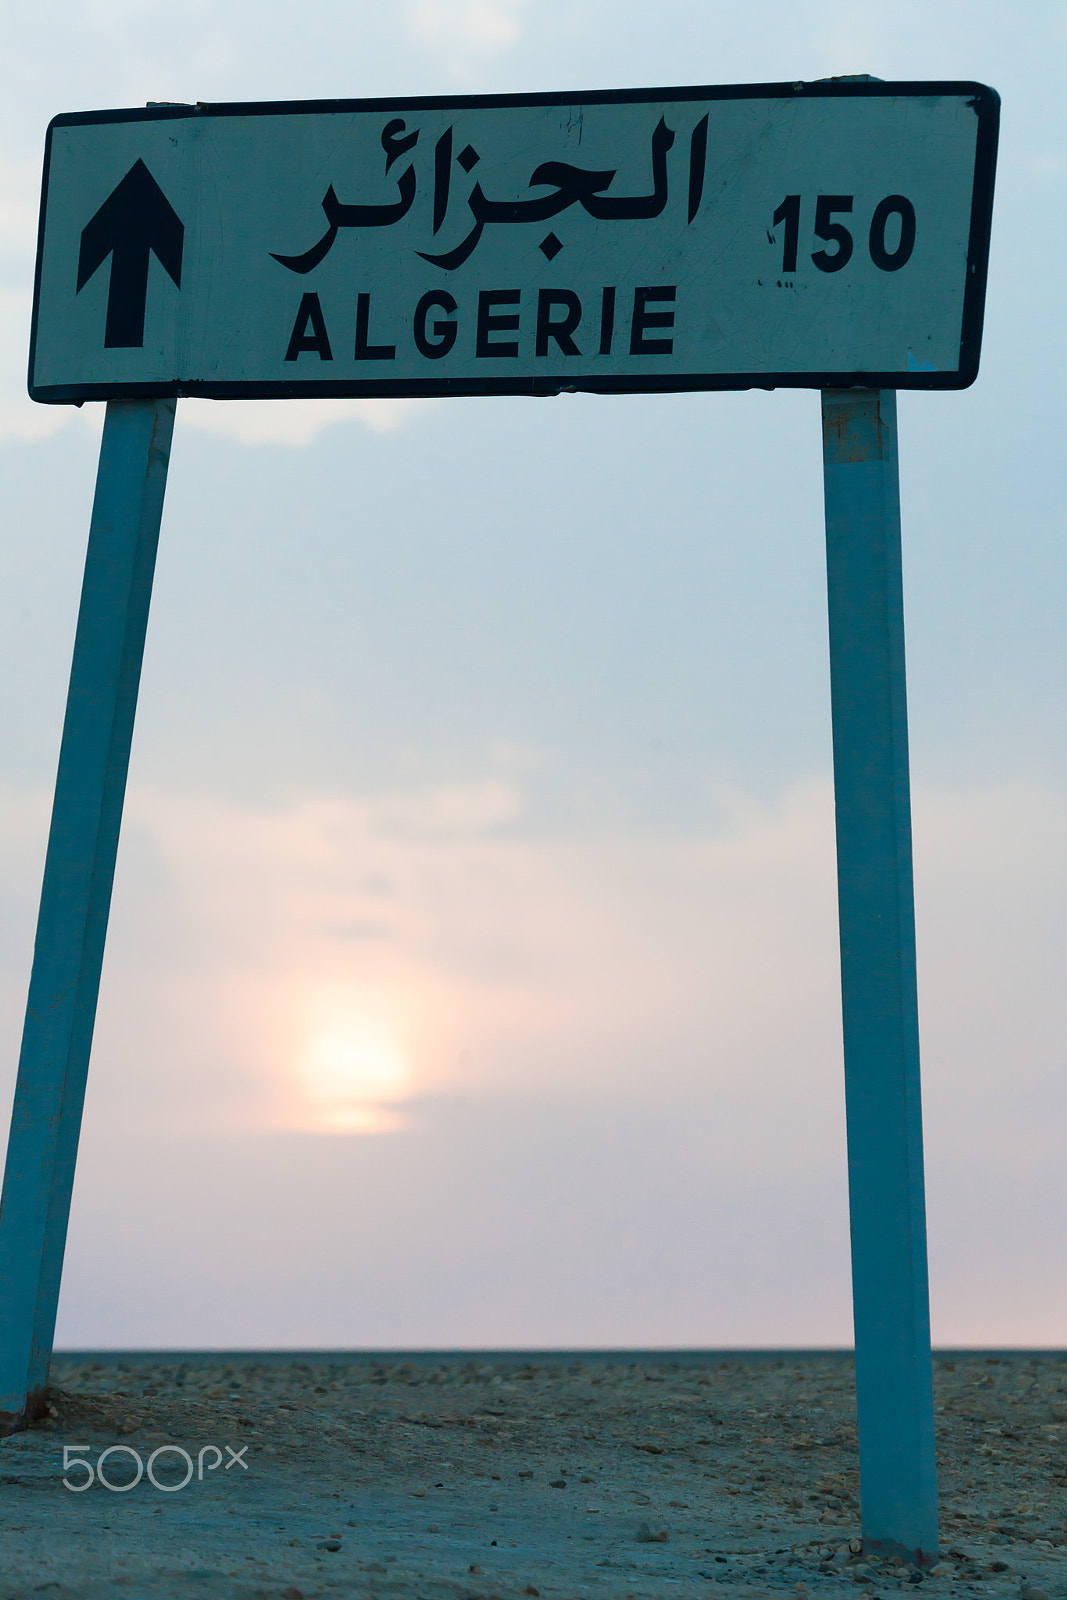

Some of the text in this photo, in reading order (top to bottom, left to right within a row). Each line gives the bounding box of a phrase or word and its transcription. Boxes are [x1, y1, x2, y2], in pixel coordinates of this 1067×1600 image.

[268, 112, 709, 274] الجزائر
[772, 194, 916, 273] 150
[283, 285, 677, 361] ALGERIE
